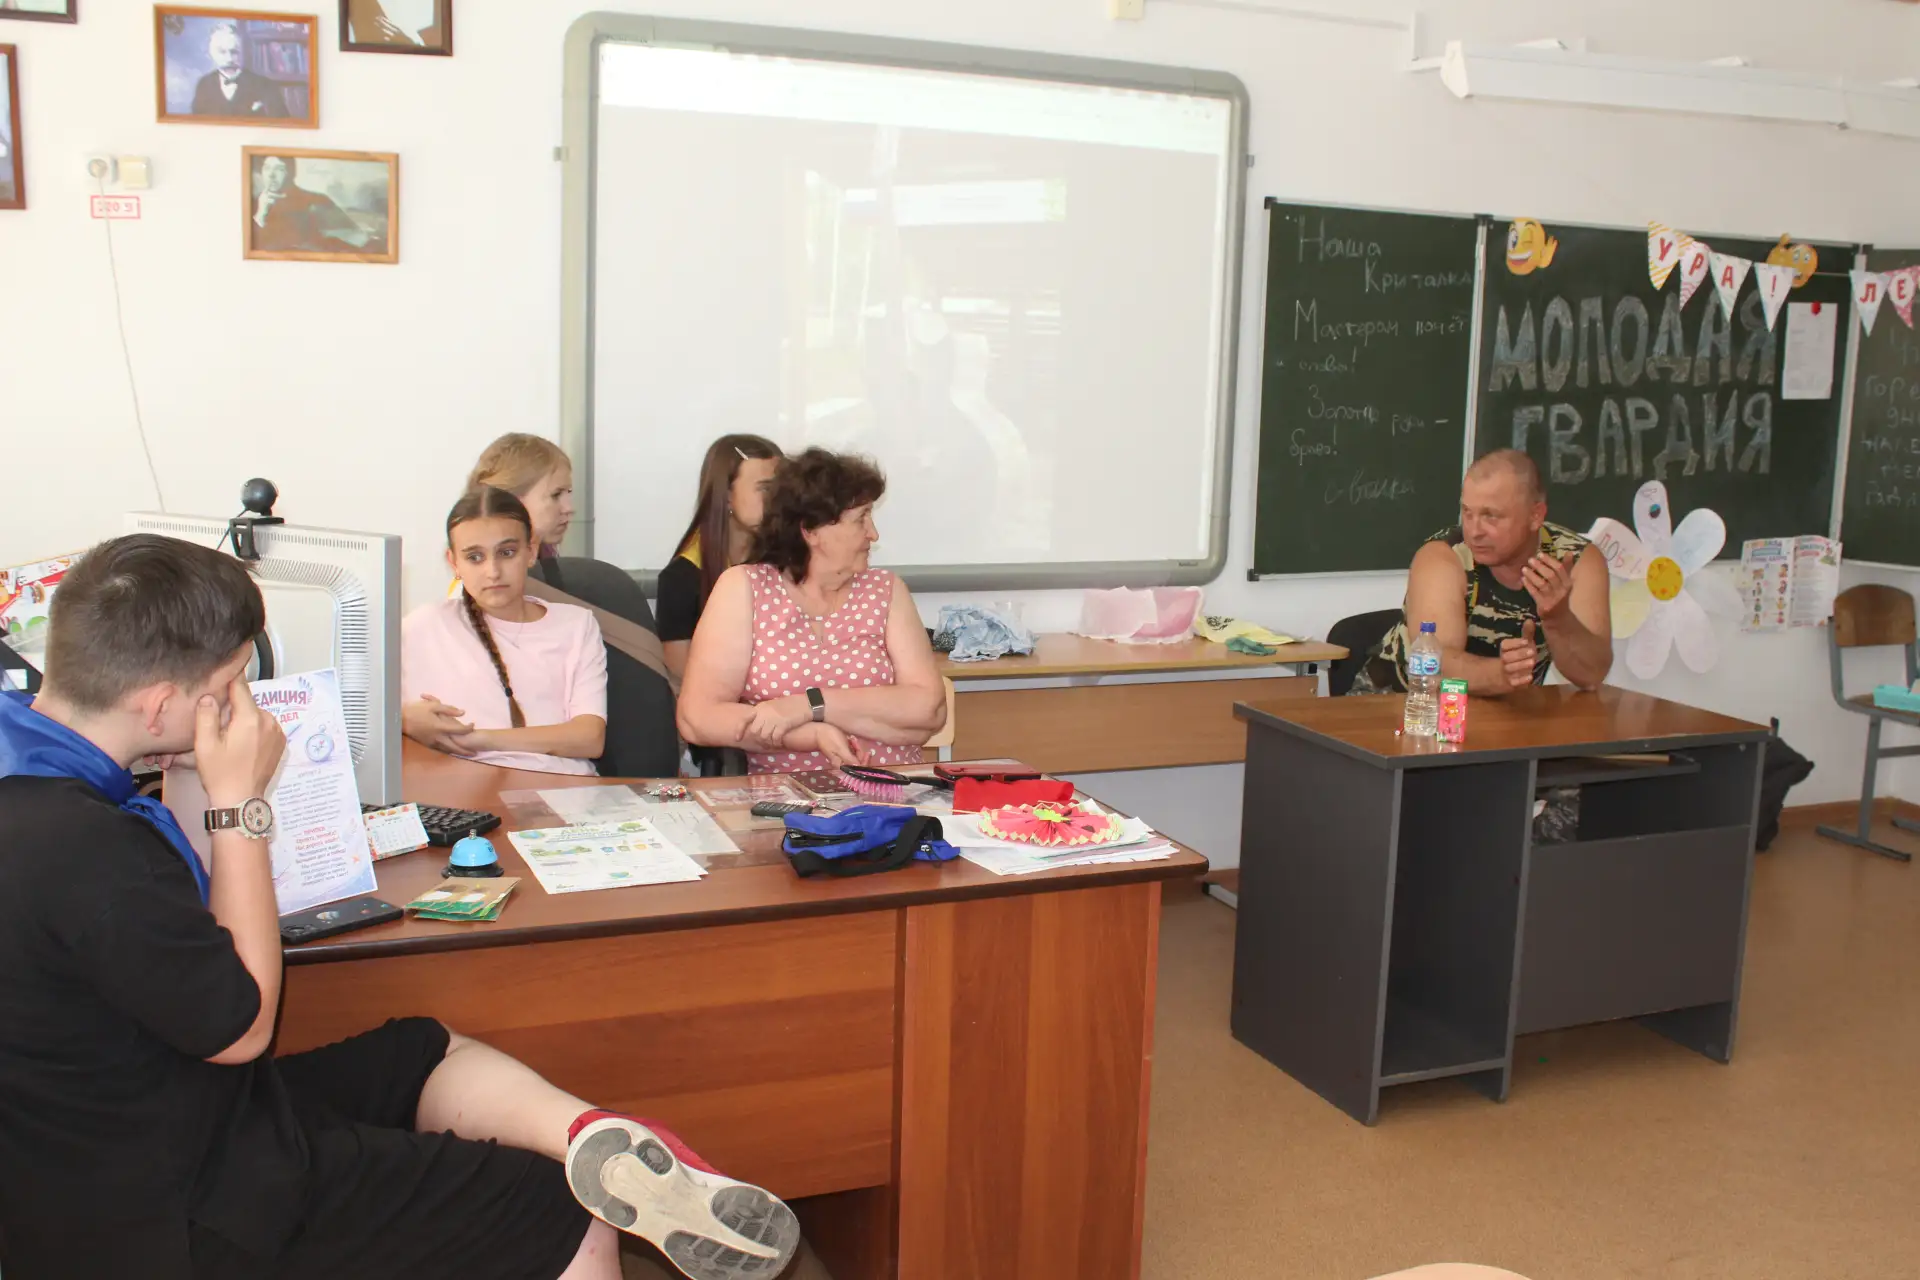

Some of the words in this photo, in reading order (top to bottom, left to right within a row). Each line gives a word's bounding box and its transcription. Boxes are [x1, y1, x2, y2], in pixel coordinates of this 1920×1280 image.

[1298, 214, 1382, 263] Наша
[1659, 237, 1777, 297] УРА!
[1488, 289, 1777, 392] МОЛОДАЯ
[1511, 389, 1773, 485] ГВАРДИЯ
